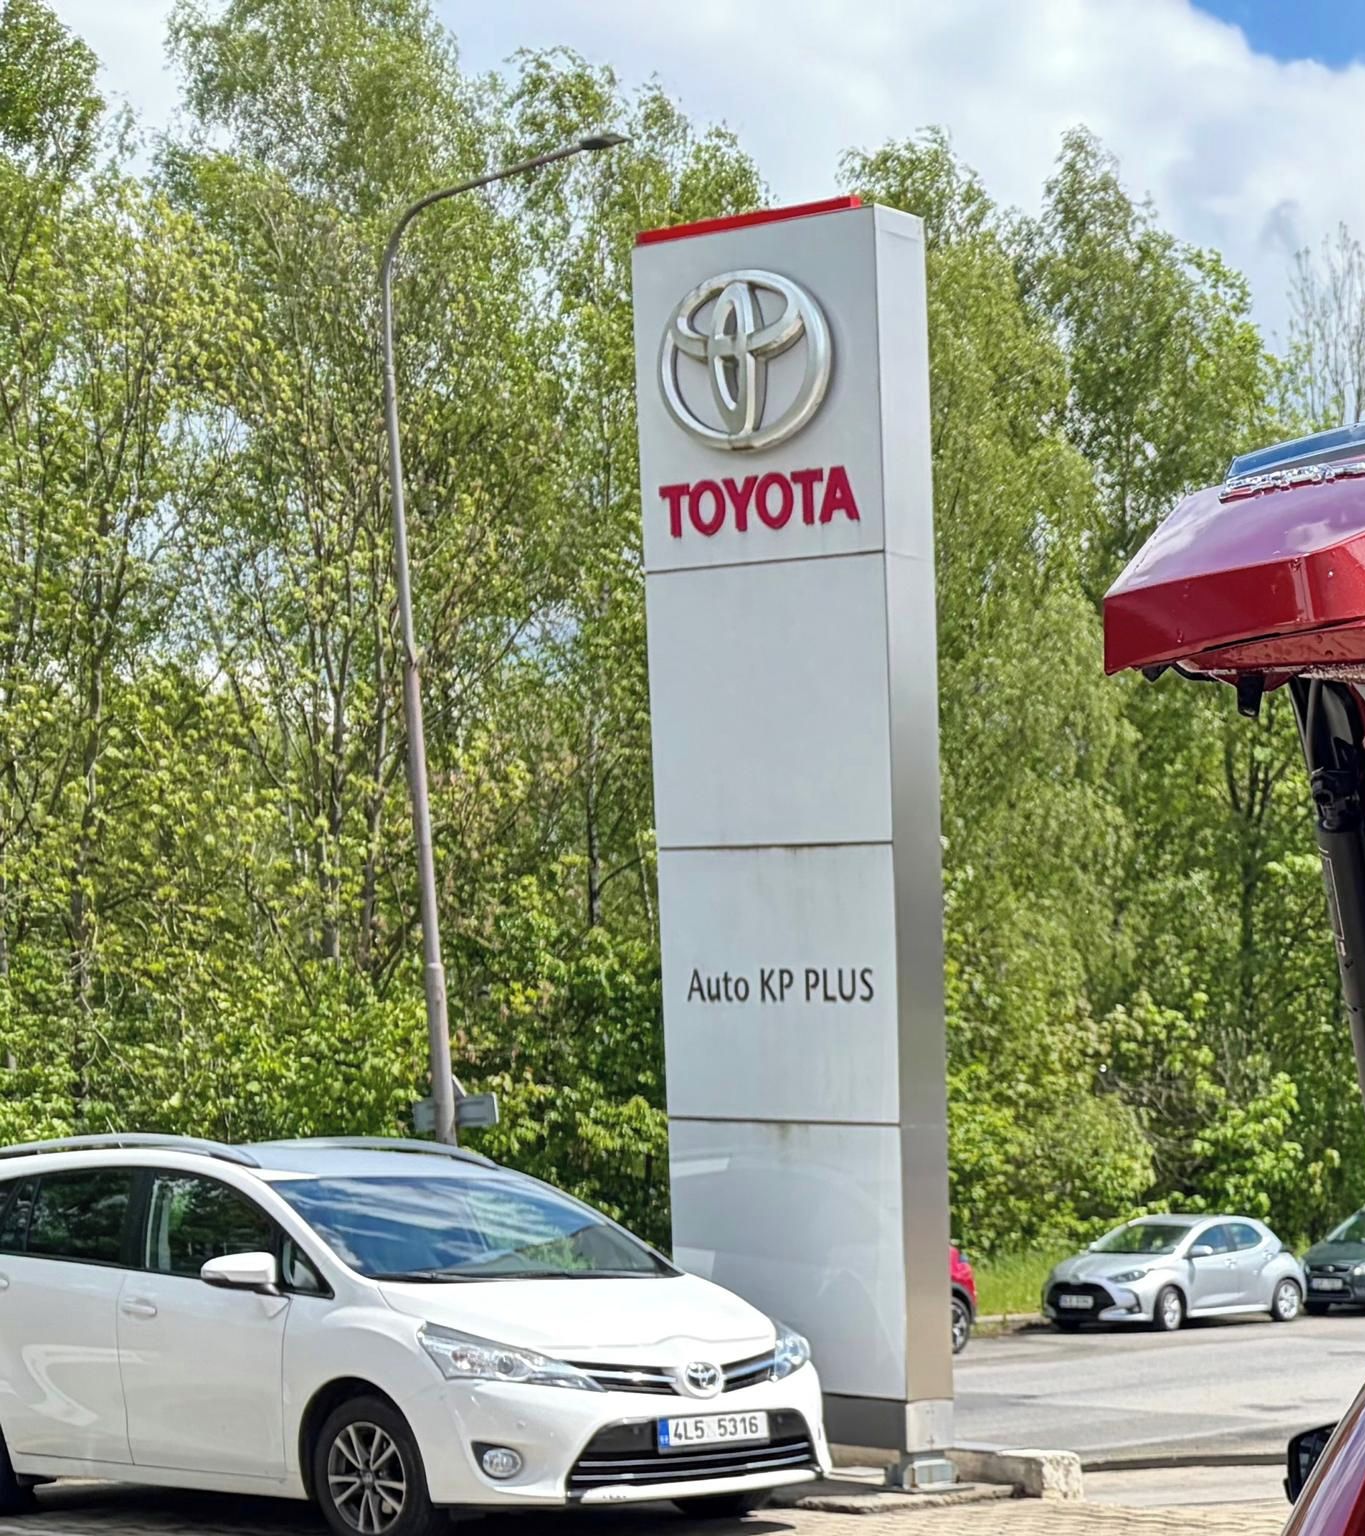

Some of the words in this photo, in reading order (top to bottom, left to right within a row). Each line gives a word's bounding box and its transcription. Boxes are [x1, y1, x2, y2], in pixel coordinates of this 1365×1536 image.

[658, 466, 861, 538] TOYOTA
[687, 967, 750, 1003] Auto
[759, 967, 794, 1002] KP
[804, 967, 875, 1003] PLUS
[672, 1419, 706, 1441] 4L5
[717, 1416, 760, 1437] 5316
